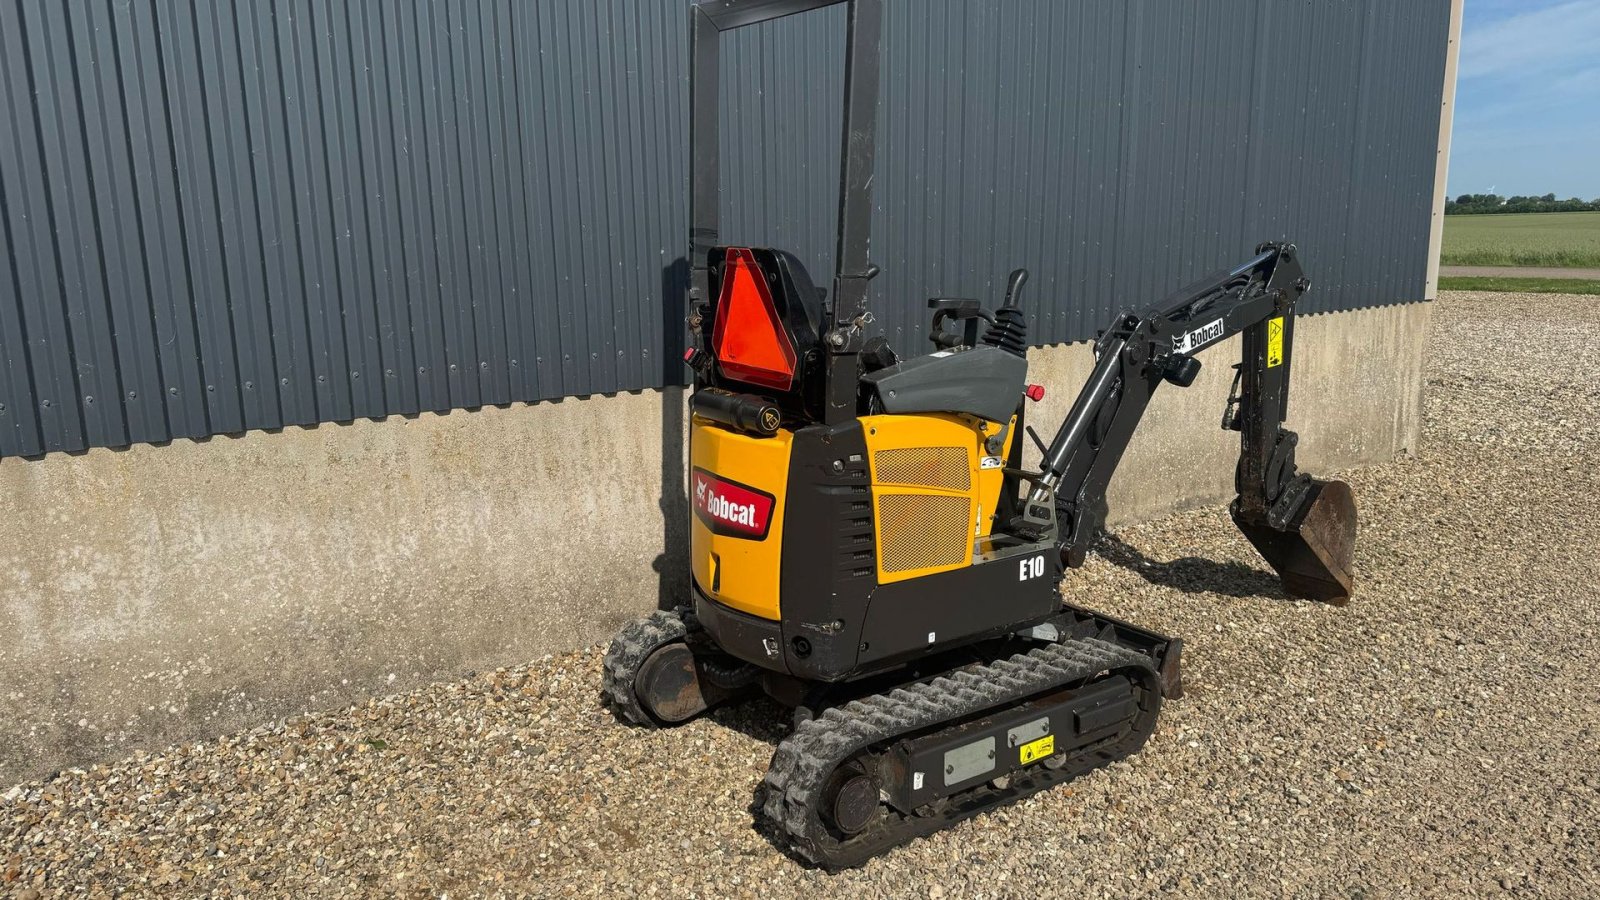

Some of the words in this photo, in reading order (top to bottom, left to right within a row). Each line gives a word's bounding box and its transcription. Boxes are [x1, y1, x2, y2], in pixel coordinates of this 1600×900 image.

[1190, 320, 1222, 348] Bobcat
[708, 489, 754, 527] Bobcat
[1020, 555, 1044, 581] E10
